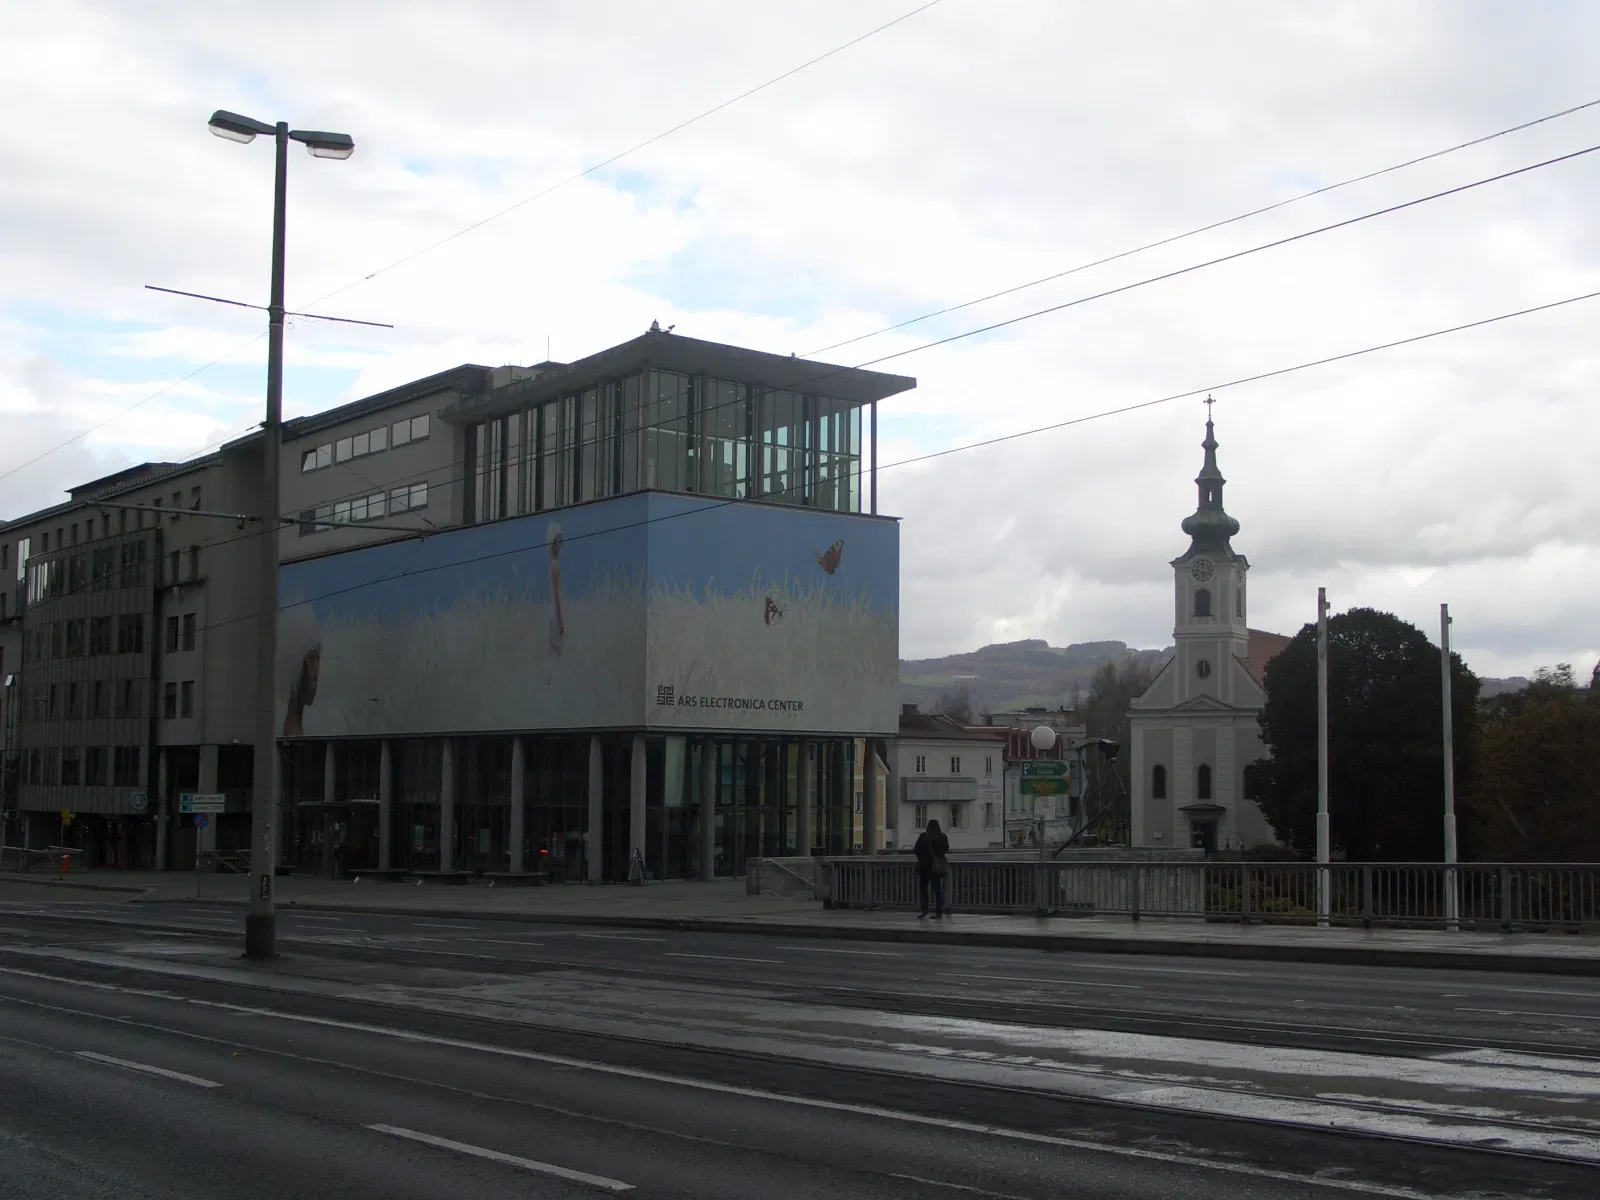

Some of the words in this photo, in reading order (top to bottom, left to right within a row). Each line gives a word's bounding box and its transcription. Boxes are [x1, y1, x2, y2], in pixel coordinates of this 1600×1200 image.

[677, 695, 698, 707] ARS
[700, 697, 765, 710] ELECTRONICA
[767, 700, 804, 712] CENTER
